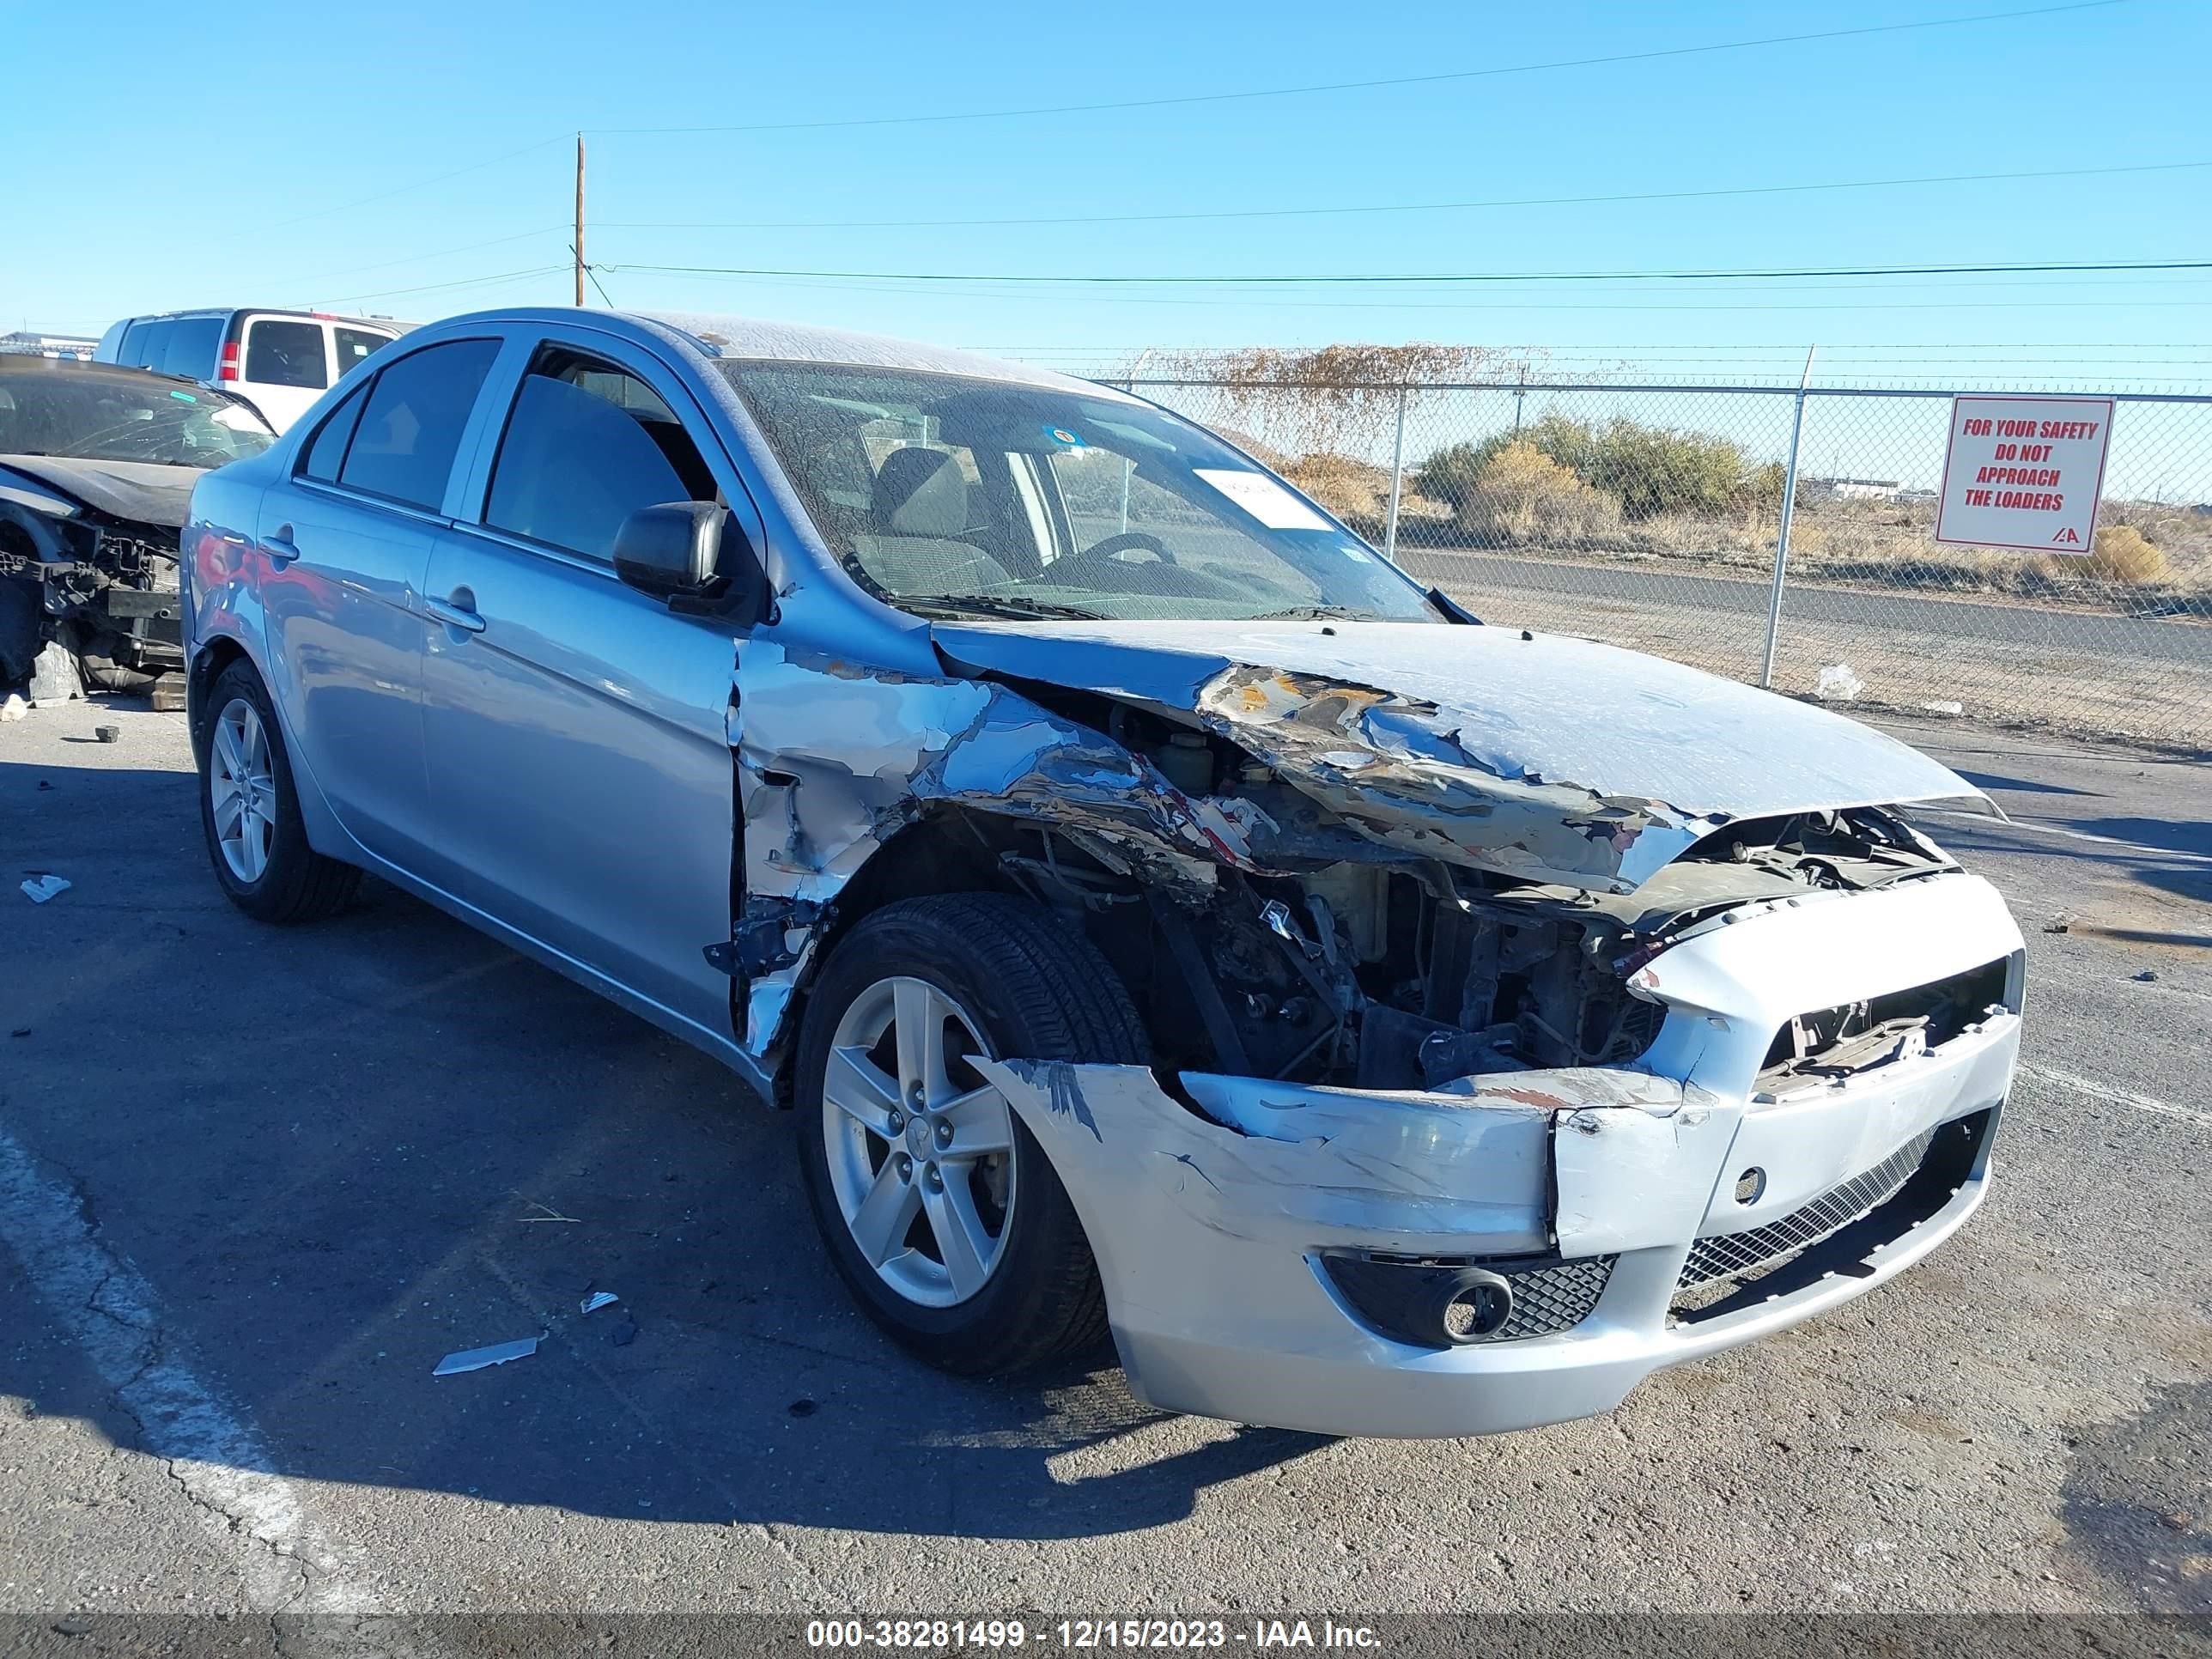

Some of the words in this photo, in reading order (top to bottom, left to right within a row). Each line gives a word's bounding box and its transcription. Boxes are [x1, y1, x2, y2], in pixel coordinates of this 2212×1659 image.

[1963, 419, 1992, 436] FOR
[1996, 420, 2037, 438] YOUR
[2040, 422, 2099, 440] SAFETY
[1995, 444, 2017, 461] DO
[2020, 445, 2053, 462] NOT
[1977, 467, 2061, 487] APPROACH
[1966, 489, 1993, 507] THE
[1994, 491, 2063, 511] LOADERS
